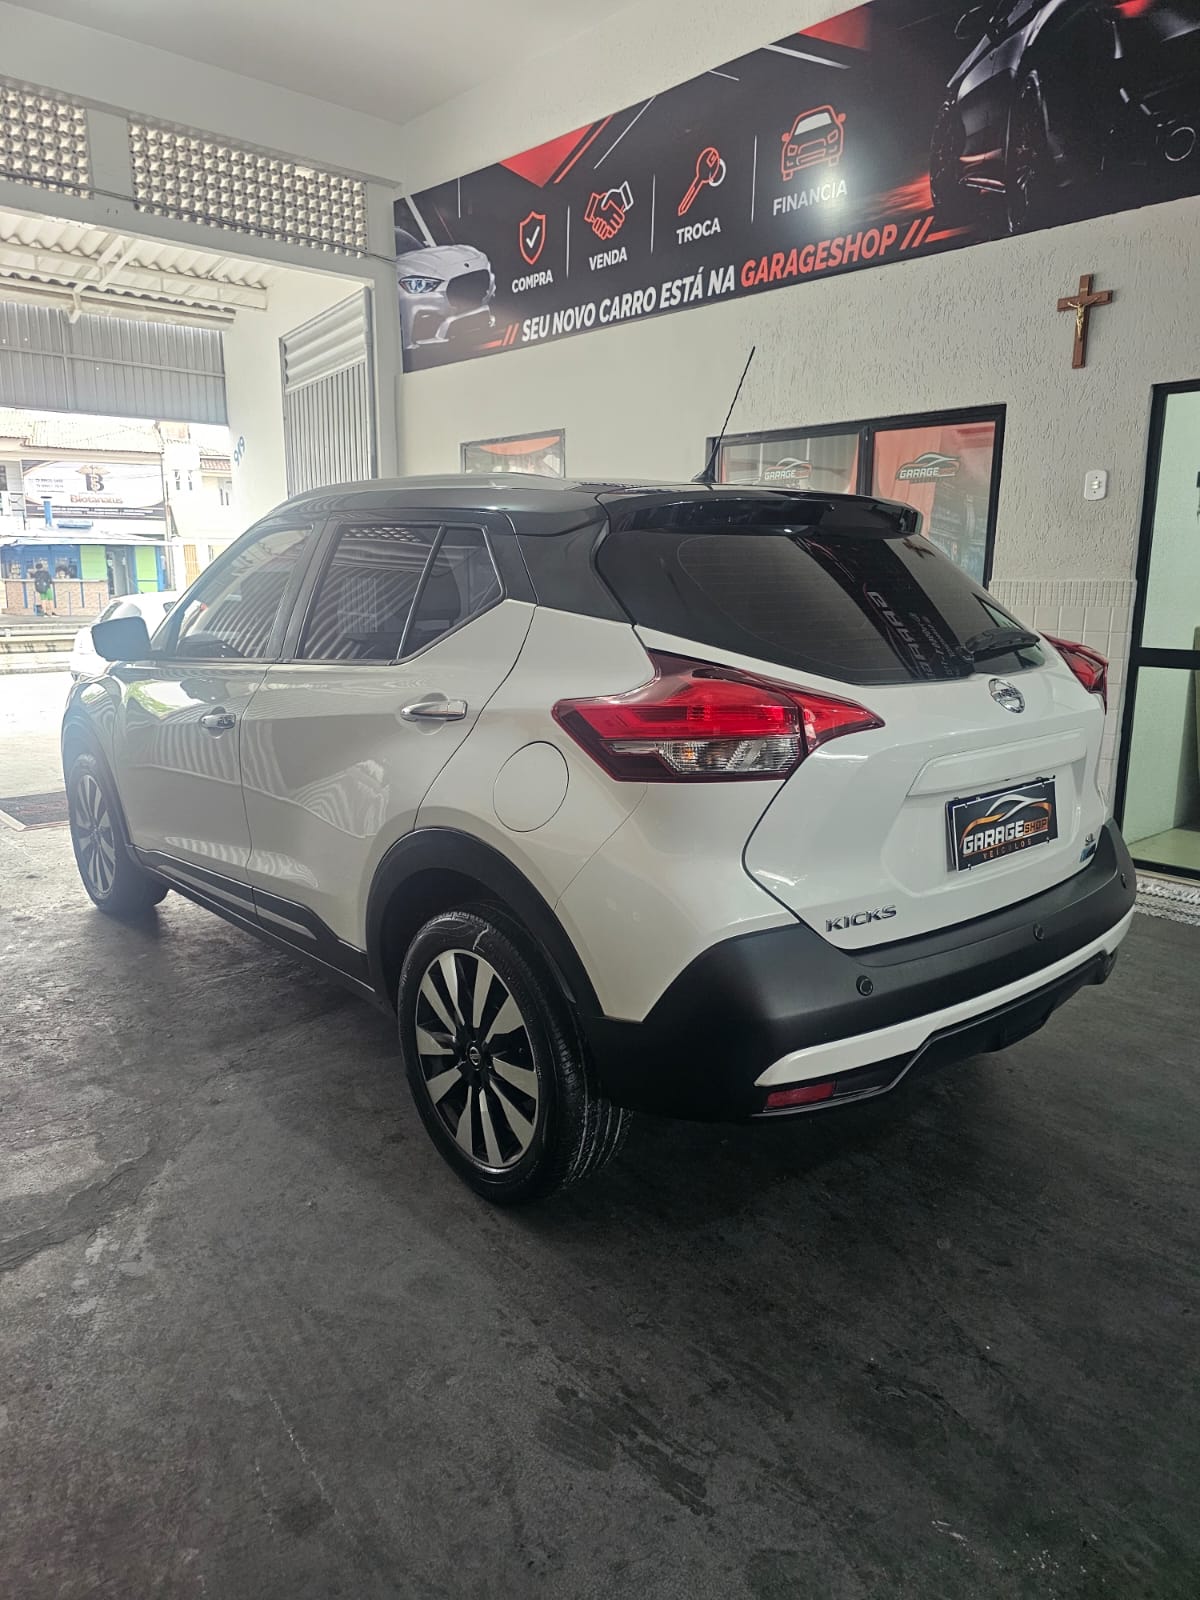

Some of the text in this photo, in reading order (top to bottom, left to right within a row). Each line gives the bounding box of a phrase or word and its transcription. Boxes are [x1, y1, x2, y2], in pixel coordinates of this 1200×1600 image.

[773, 180, 848, 216] FINANCIA
[676, 217, 721, 244] TROCA
[589, 247, 628, 271] VENDA
[511, 269, 553, 293] COMPRA
[522, 224, 898, 342] SEU NOVO CARRO ESTÁ NA GARAGESHOP
[764, 470, 797, 480] GARAGE
[900, 467, 939, 478] GARAGE
[826, 905, 897, 932] KICKS
